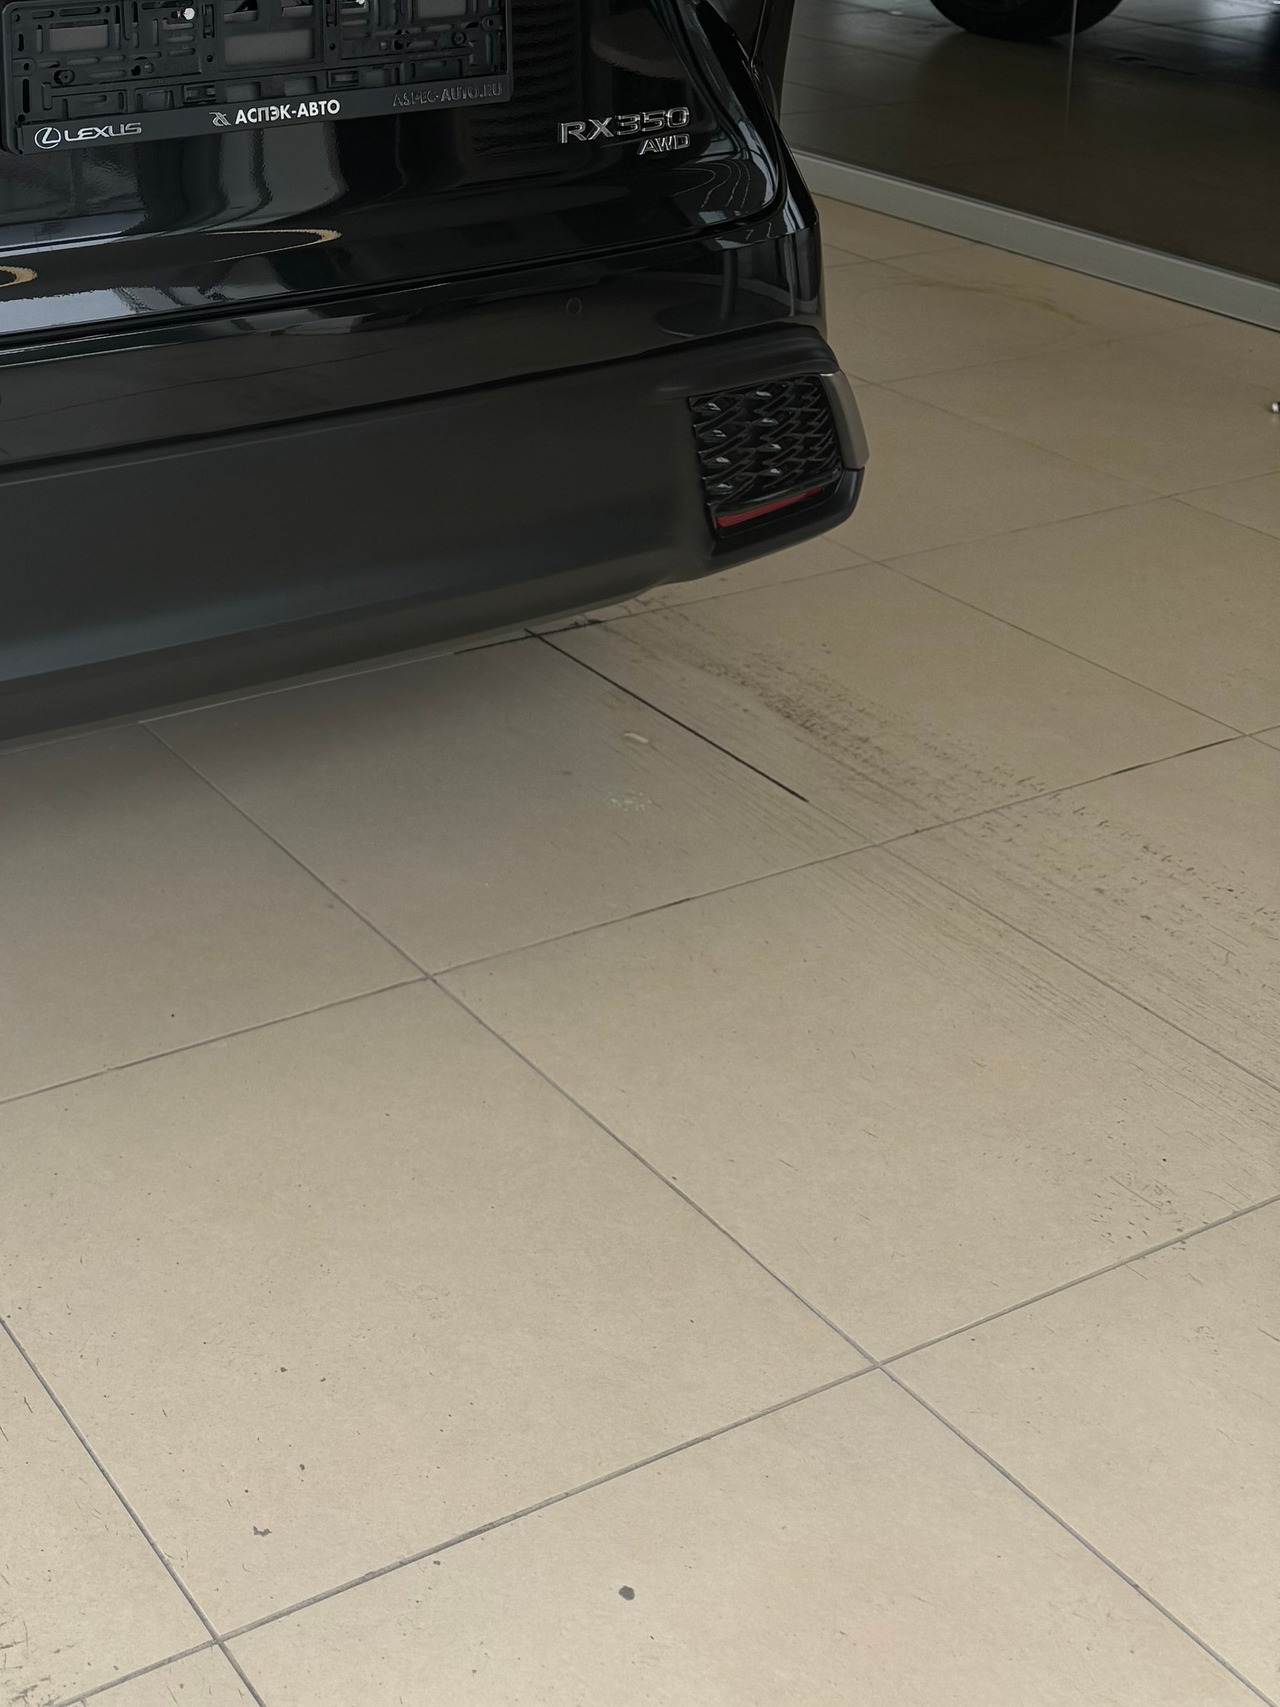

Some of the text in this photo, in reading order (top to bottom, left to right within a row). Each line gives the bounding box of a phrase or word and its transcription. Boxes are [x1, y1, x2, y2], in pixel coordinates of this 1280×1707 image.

[234, 99, 340, 125] АСПЭК-АВТО
[64, 122, 142, 142] LEXUS
[558, 106, 690, 144] RX350
[637, 133, 691, 155] AWD
